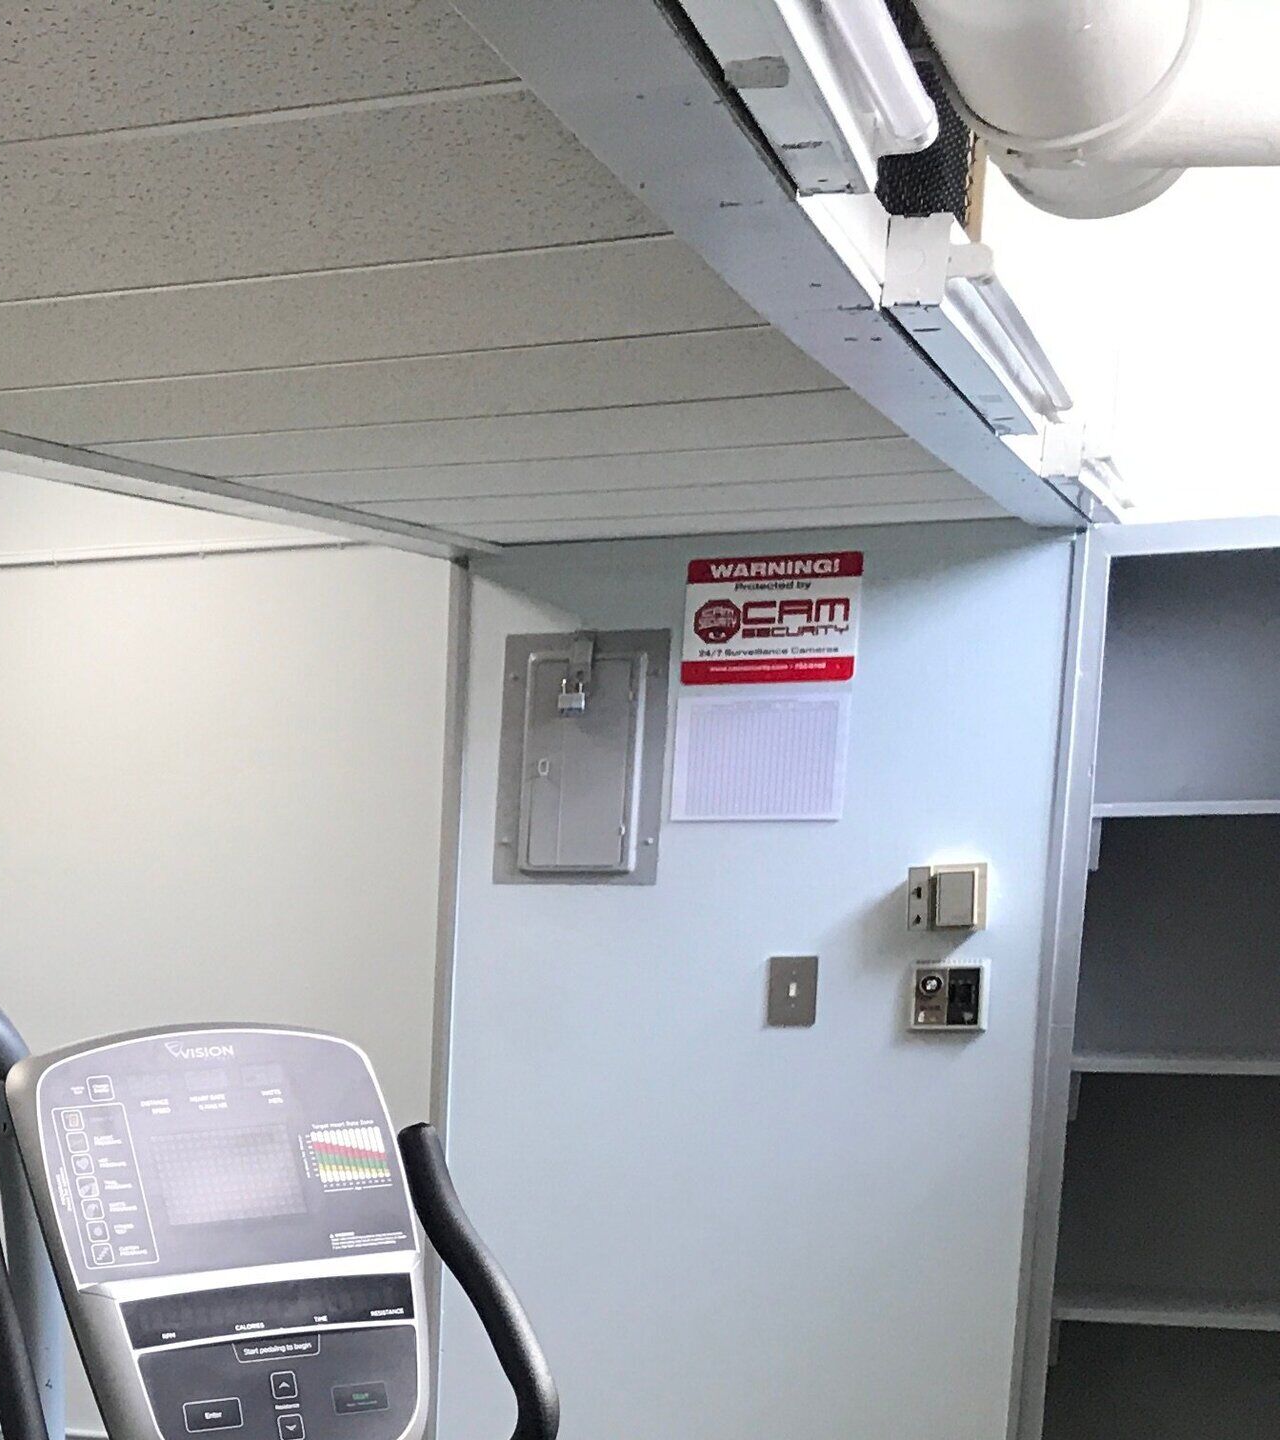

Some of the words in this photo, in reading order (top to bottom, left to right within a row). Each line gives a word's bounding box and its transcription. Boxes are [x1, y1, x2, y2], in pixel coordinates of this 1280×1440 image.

[710, 558, 840, 578] WARNING!
[734, 581, 794, 591] Protected
[796, 581, 811, 590] by
[742, 598, 850, 625] CAM
[742, 625, 849, 638] SECURITY
[698, 649, 722, 658] 24/7
[724, 647, 788, 656] Surveillance
[791, 646, 839, 655] Cameras
[179, 1045, 234, 1059] VISION
[235, 1322, 265, 1331] CALORIES
[243, 1347, 259, 1356] Start
[286, 1344, 293, 1352] to
[294, 1342, 312, 1352] begin
[204, 1411, 223, 1420] Enter
